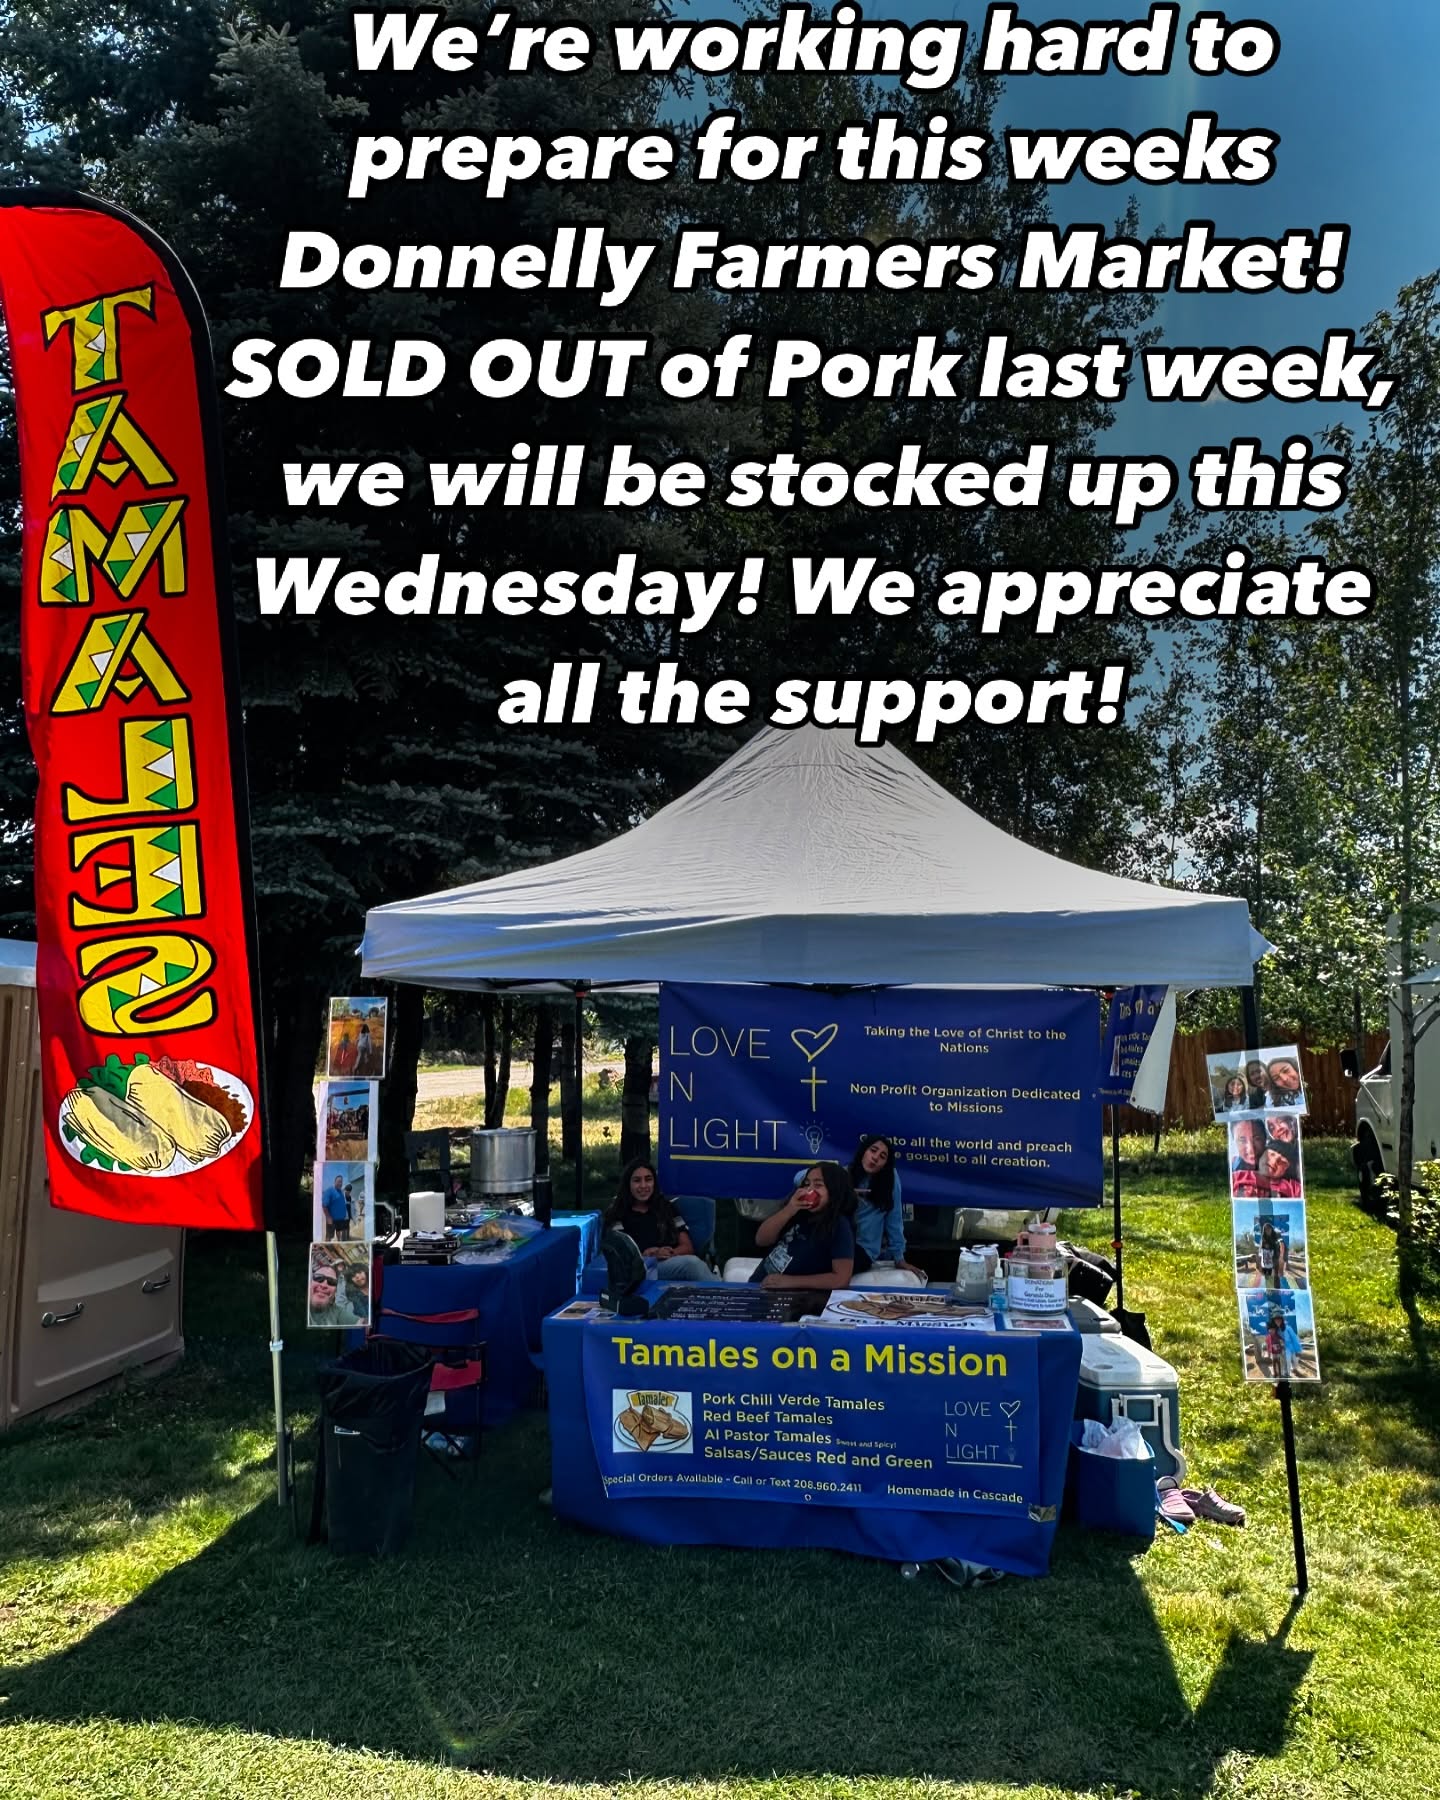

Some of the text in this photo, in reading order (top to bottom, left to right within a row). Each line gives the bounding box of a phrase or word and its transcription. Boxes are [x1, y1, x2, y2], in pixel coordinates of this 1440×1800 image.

[864, 1025, 1067, 1040] Taking the Love of Christ to the
[670, 1025, 771, 1059] LOVE
[940, 1042, 989, 1053] Nations
[670, 1071, 693, 1102] N
[850, 1083, 1081, 1101] Non Profit Organization Dedicated
[929, 1101, 1003, 1114] to Missions
[669, 1116, 788, 1151] LIGHT
[910, 1136, 926, 1147] all
[930, 1137, 951, 1149] the
[955, 1139, 993, 1150] world
[997, 1140, 1022, 1151] and
[1026, 1141, 1072, 1153] preach
[906, 1152, 950, 1163] gospel
[953, 1153, 968, 1164] to
[971, 1154, 987, 1165] all
[990, 1156, 1050, 1168] creation.
[611, 1336, 1007, 1377] Tamales on a Mission
[702, 1392, 736, 1405] Pork
[777, 1393, 821, 1407] Verde
[824, 1396, 885, 1411] Tamales
[944, 1401, 992, 1417] LOVE
[703, 1409, 833, 1425] Red Beef Tamales
[704, 1428, 832, 1445] Al Pastor Tamales
[945, 1422, 958, 1438] N
[858, 1440, 873, 1448] and
[945, 1443, 1000, 1461] LIGHT
[704, 1446, 933, 1469] Salsas/Sauces Red and Green
[602, 1473, 636, 1486] Special
[638, 1473, 673, 1482] Orders
[676, 1473, 724, 1484] Available
[732, 1475, 753, 1485] Call
[755, 1478, 767, 1486] or
[769, 1477, 791, 1488] Text
[793, 1479, 862, 1493] 208.960.2411
[887, 1484, 1023, 1504] Homemade in Cascade
